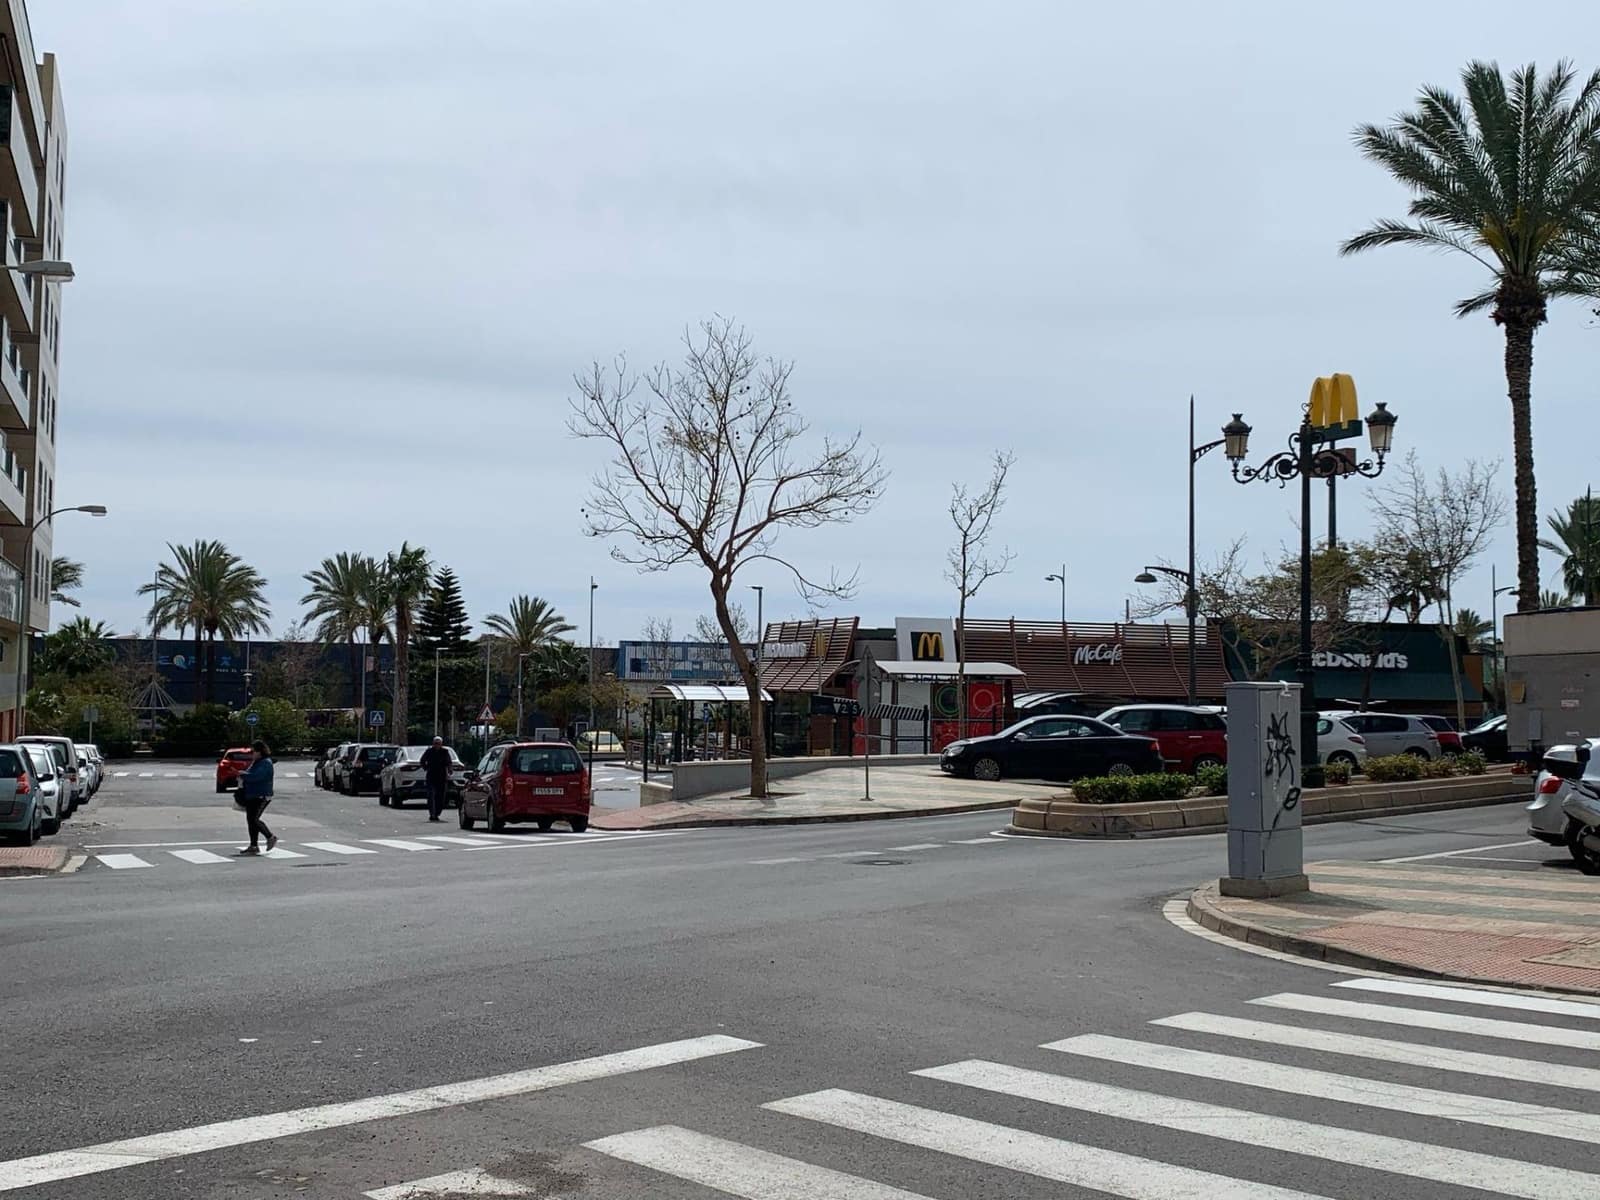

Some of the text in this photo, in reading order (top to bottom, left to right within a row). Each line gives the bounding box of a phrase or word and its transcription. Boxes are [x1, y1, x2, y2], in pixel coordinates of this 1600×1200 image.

[917, 632, 945, 659] M
[1073, 643, 1123, 665] McCafé
[1311, 651, 1409, 669] cDonld's
